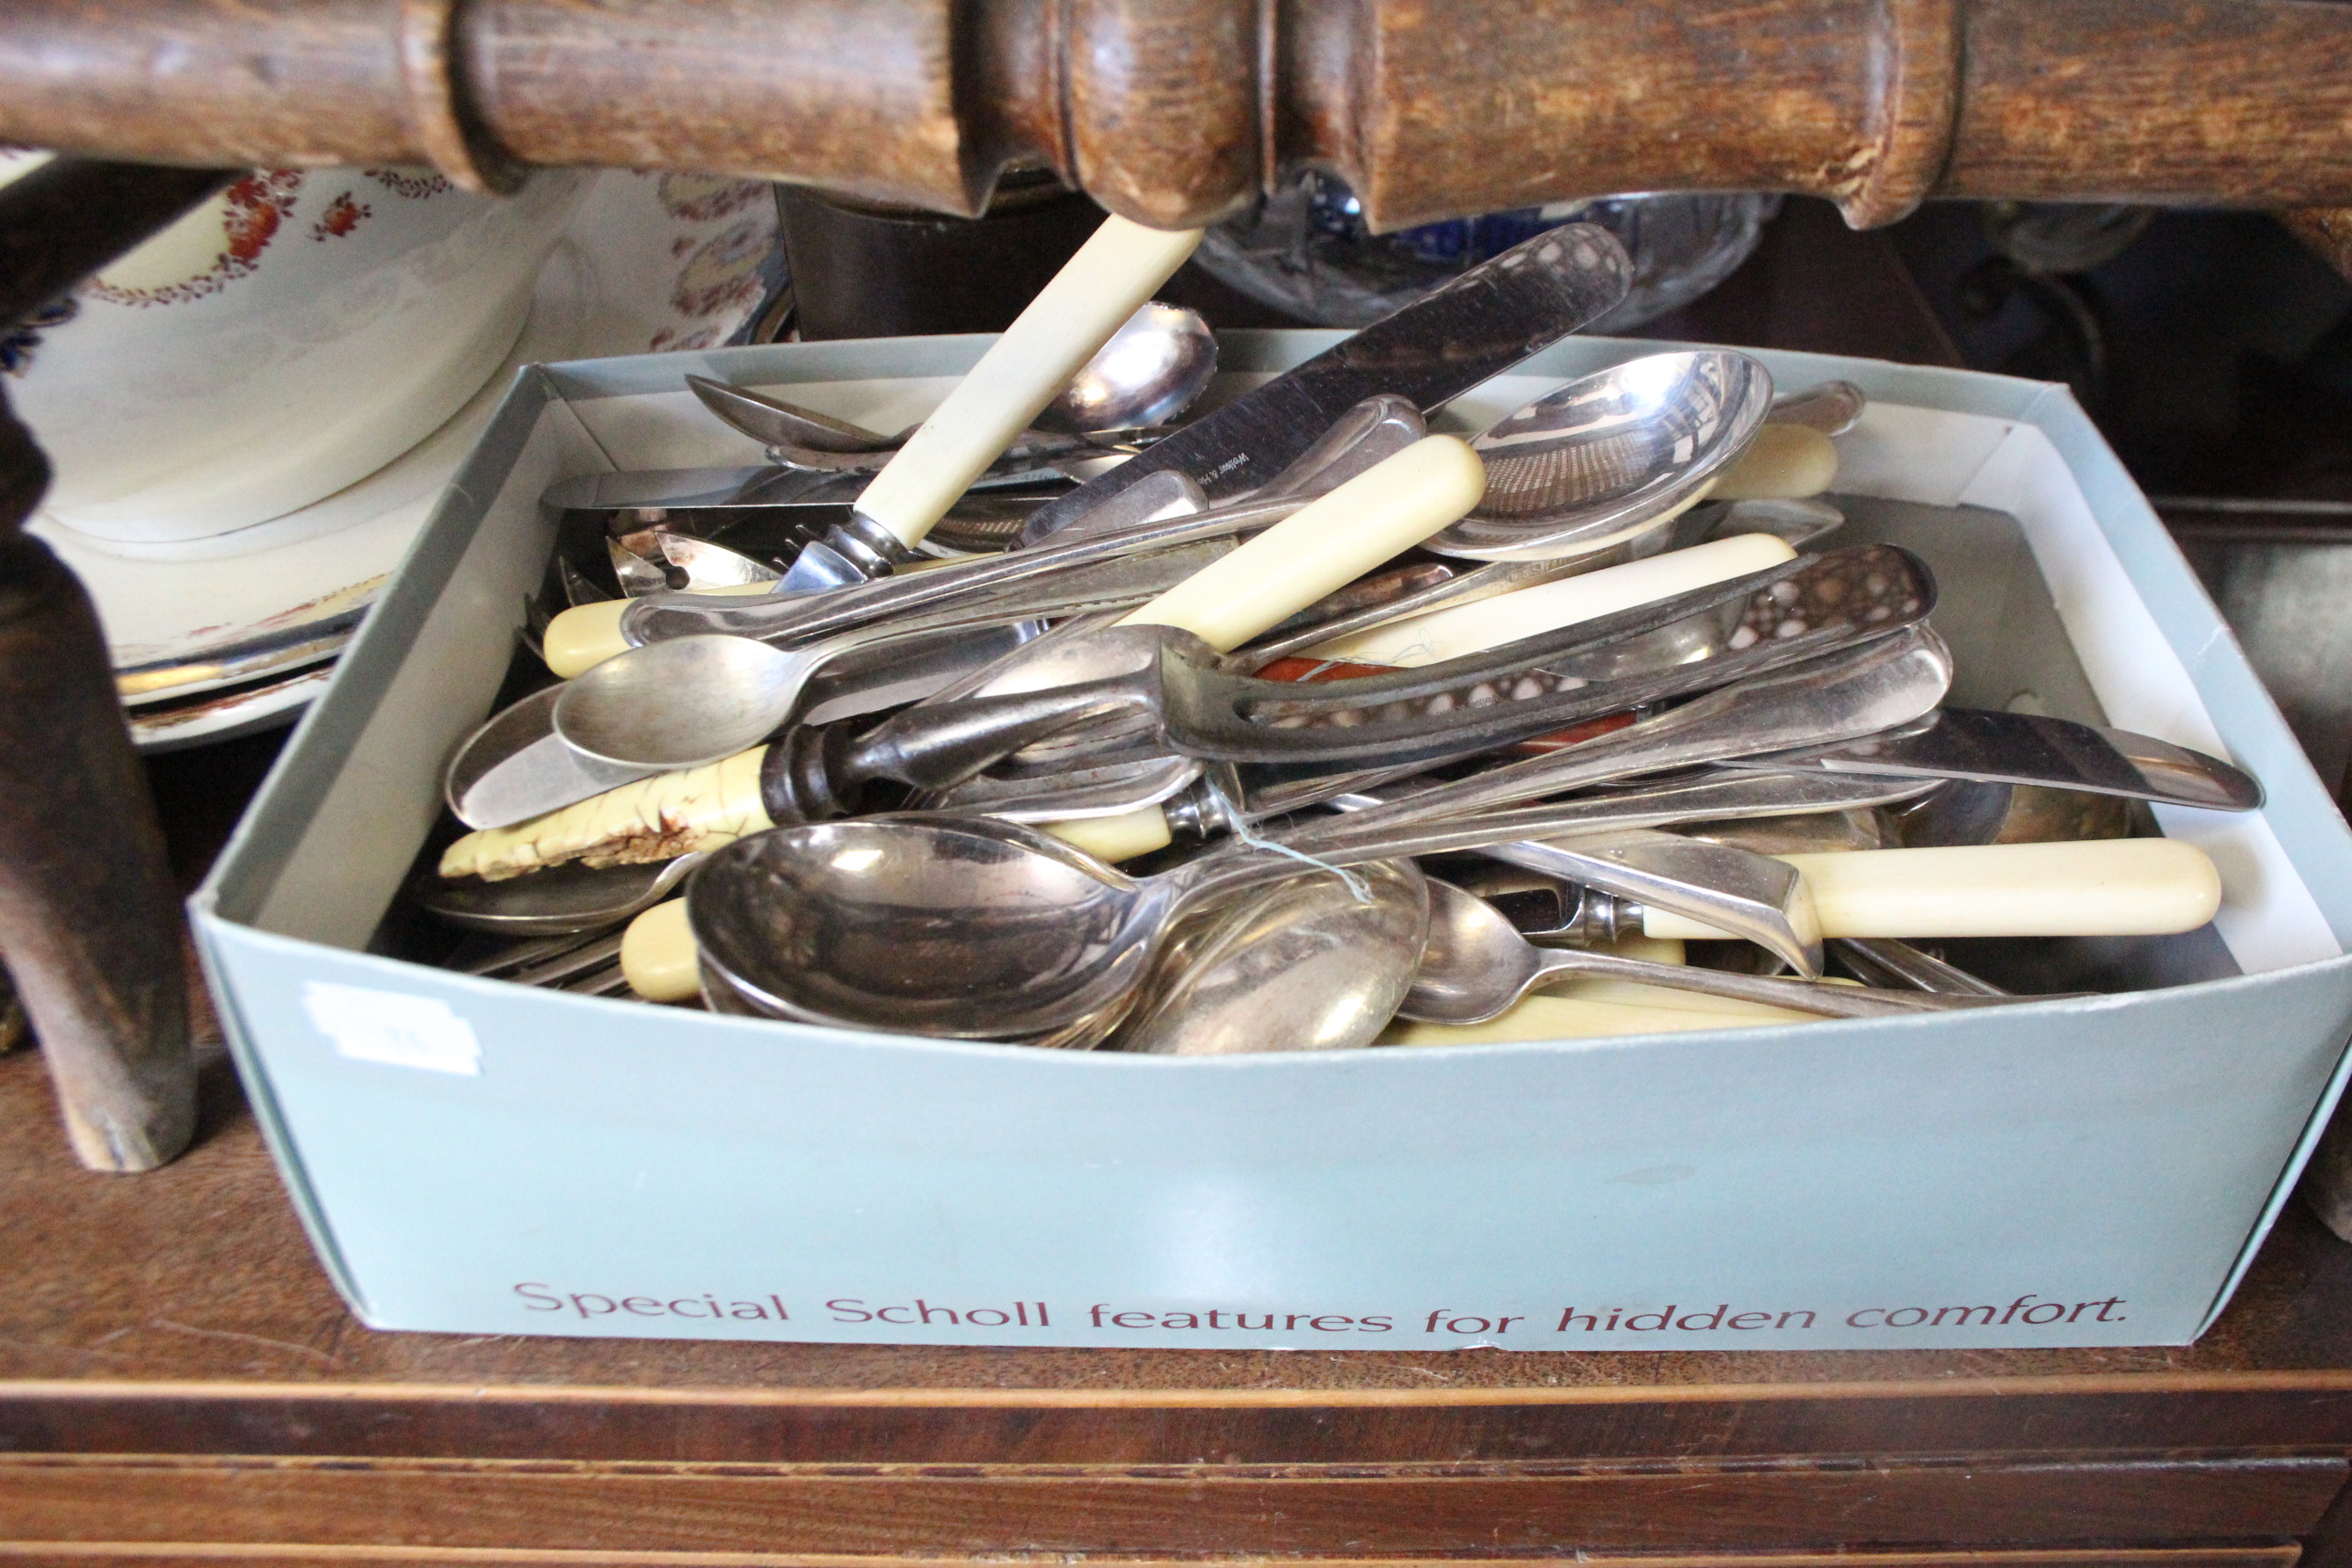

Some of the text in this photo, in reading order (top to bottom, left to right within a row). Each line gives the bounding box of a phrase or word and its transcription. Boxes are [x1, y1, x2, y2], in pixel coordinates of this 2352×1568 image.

[513, 1282, 2128, 1335] Special Scholl features for hidden comfort.
